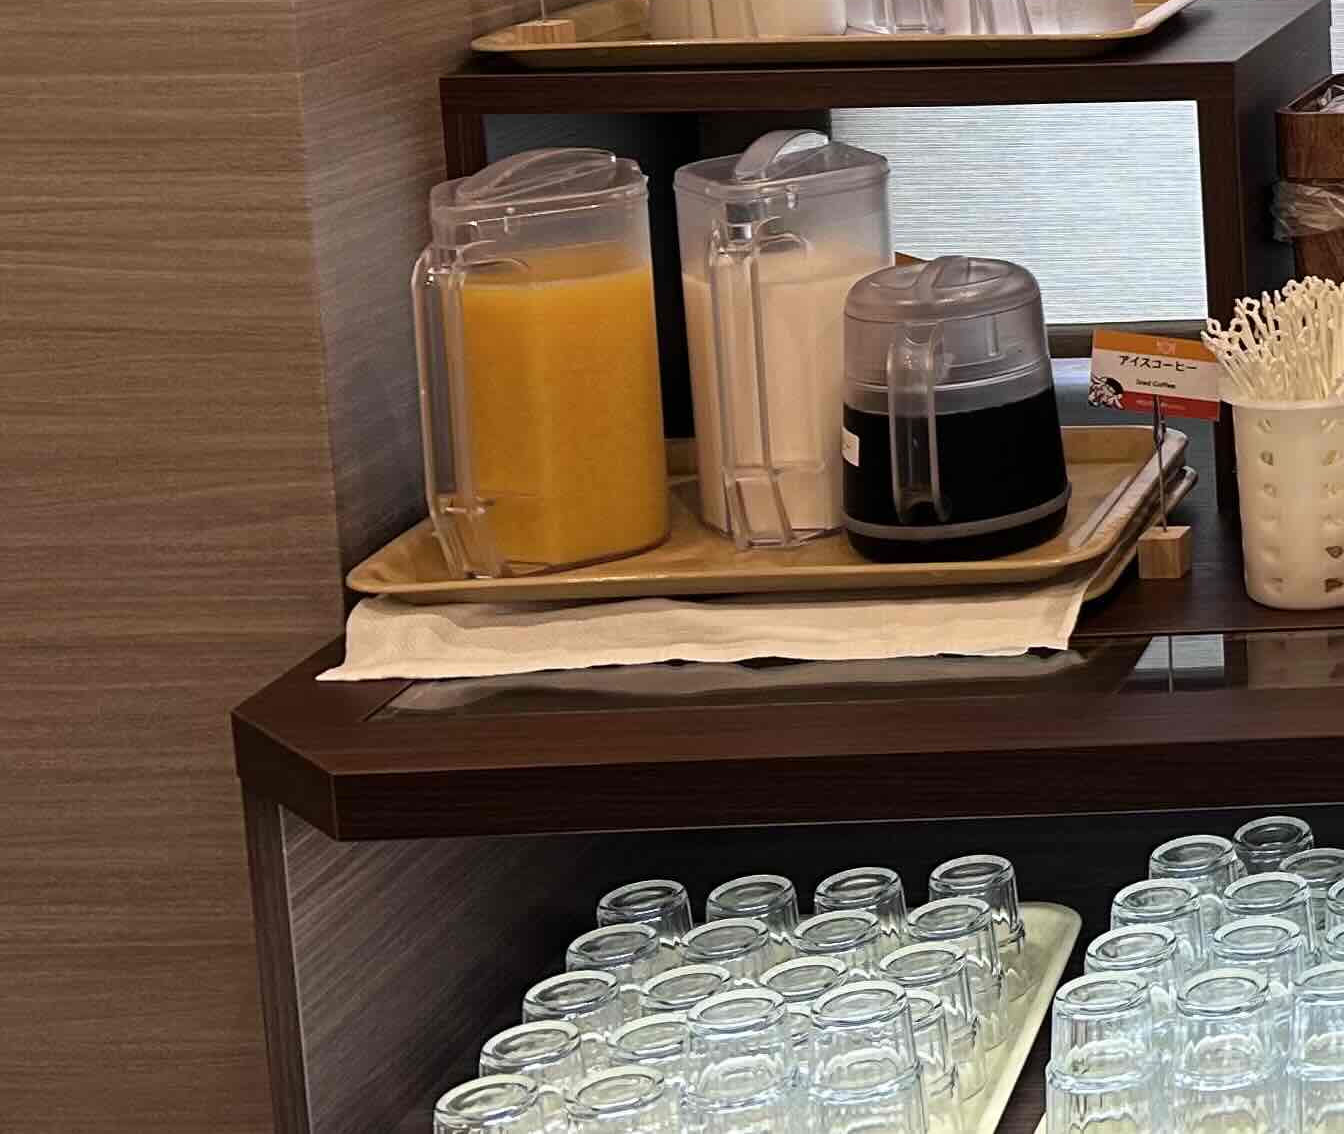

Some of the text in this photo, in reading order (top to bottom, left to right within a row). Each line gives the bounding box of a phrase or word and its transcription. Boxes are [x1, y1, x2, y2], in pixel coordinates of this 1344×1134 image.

[1119, 354, 1198, 372] アイスコーヒー
